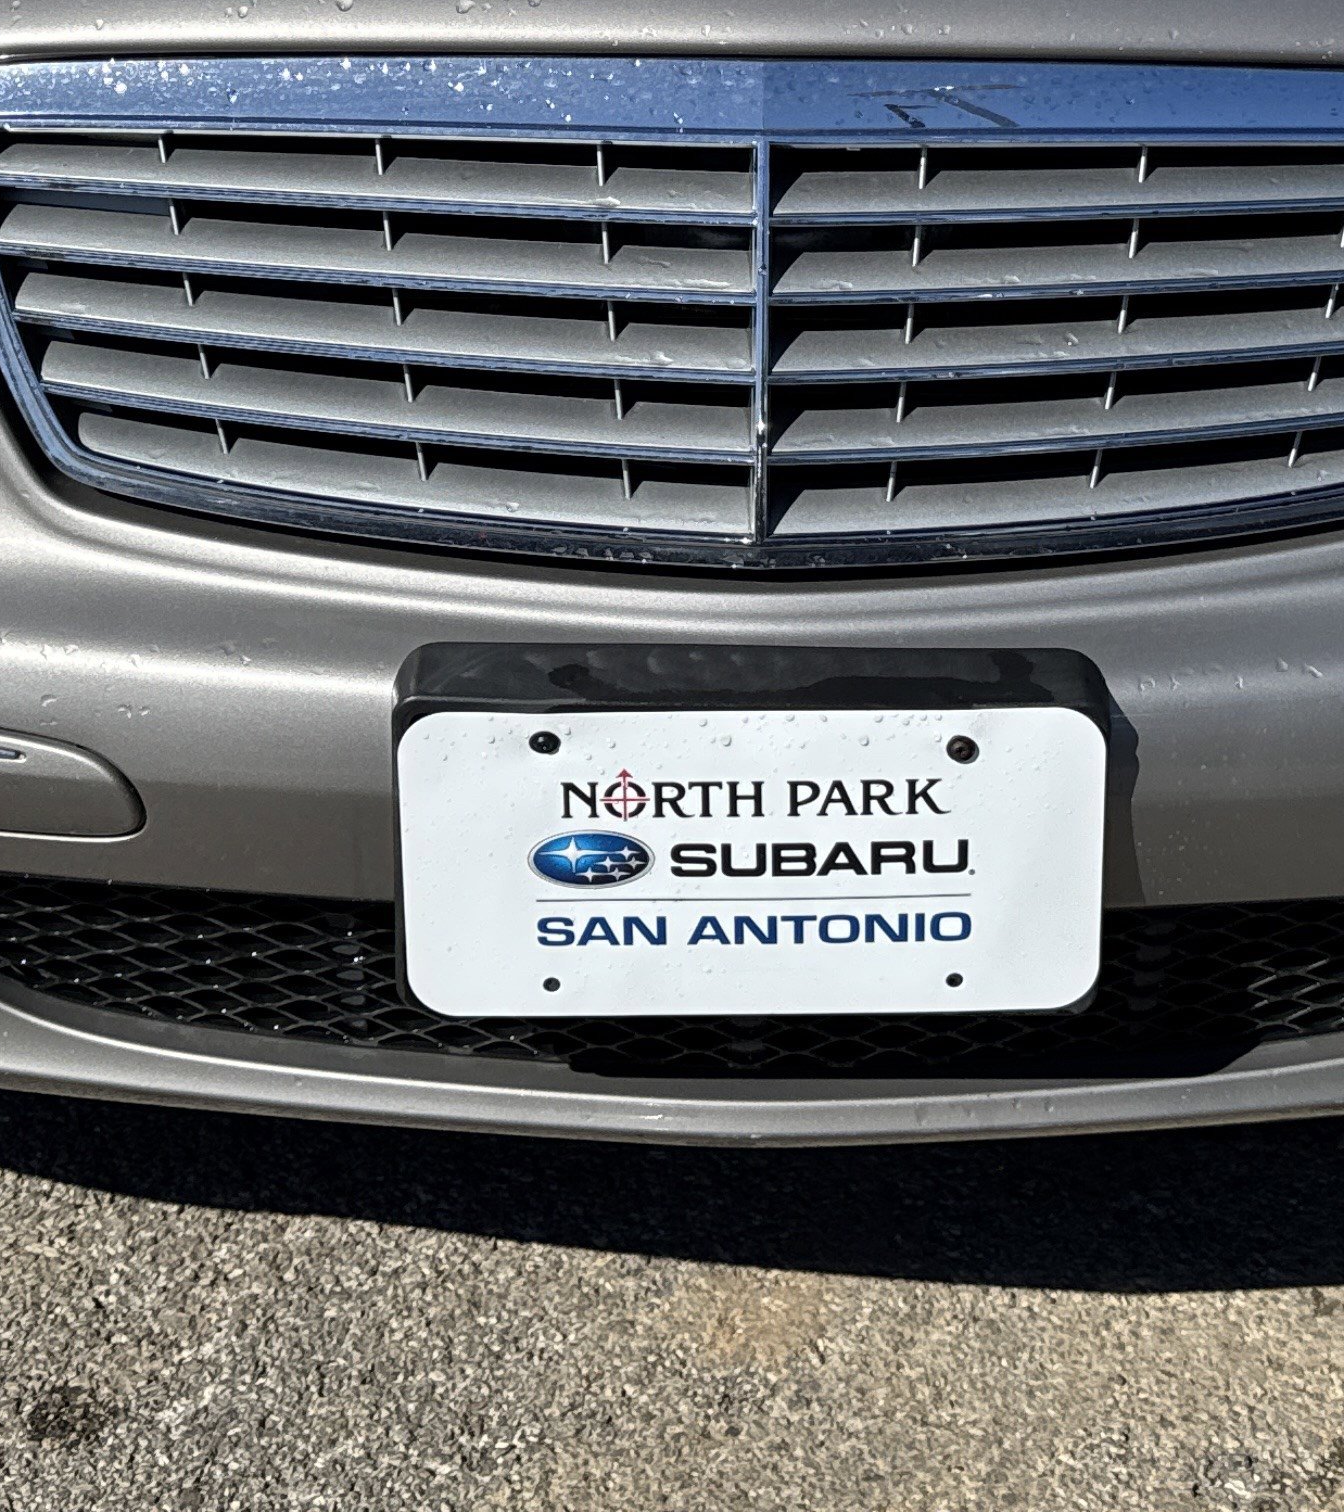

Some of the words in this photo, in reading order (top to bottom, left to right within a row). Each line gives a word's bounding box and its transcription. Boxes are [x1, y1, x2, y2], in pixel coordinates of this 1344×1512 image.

[560, 776, 765, 821] NORTH
[788, 777, 951, 818] PARK
[670, 838, 970, 877] SUBARU
[536, 914, 669, 947] SAN
[687, 910, 973, 946] ANTONIO
